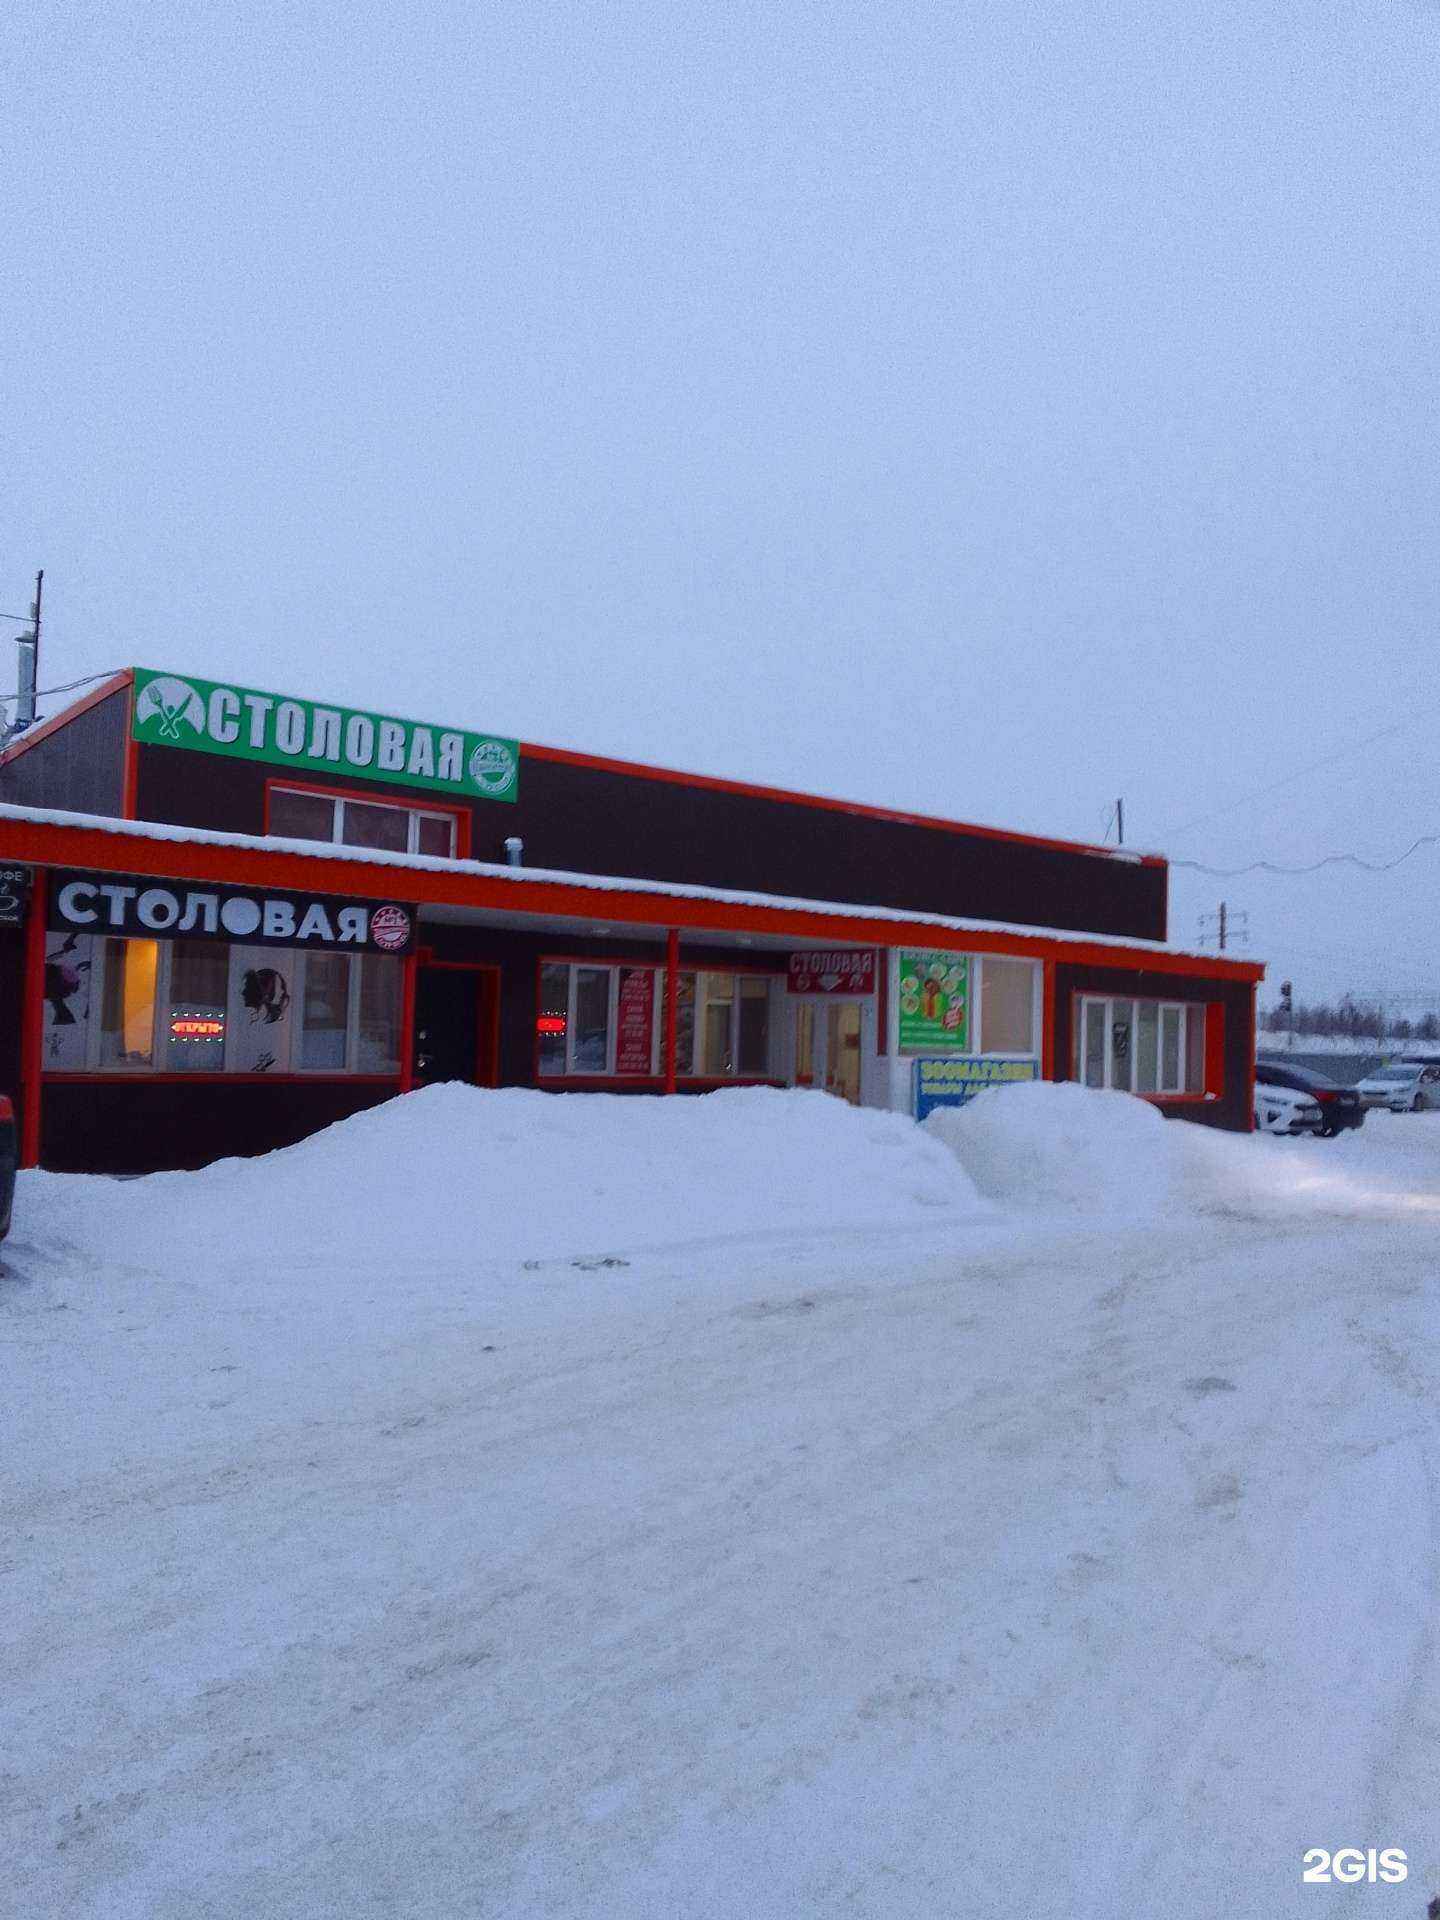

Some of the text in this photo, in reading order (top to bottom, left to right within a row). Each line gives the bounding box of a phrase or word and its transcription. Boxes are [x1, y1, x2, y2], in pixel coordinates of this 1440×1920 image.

[207, 688, 464, 782] СТОЛОВАЯ
[58, 882, 368, 943] СТОЛОВАЯ
[789, 951, 873, 974] СТОЛОВАЯ
